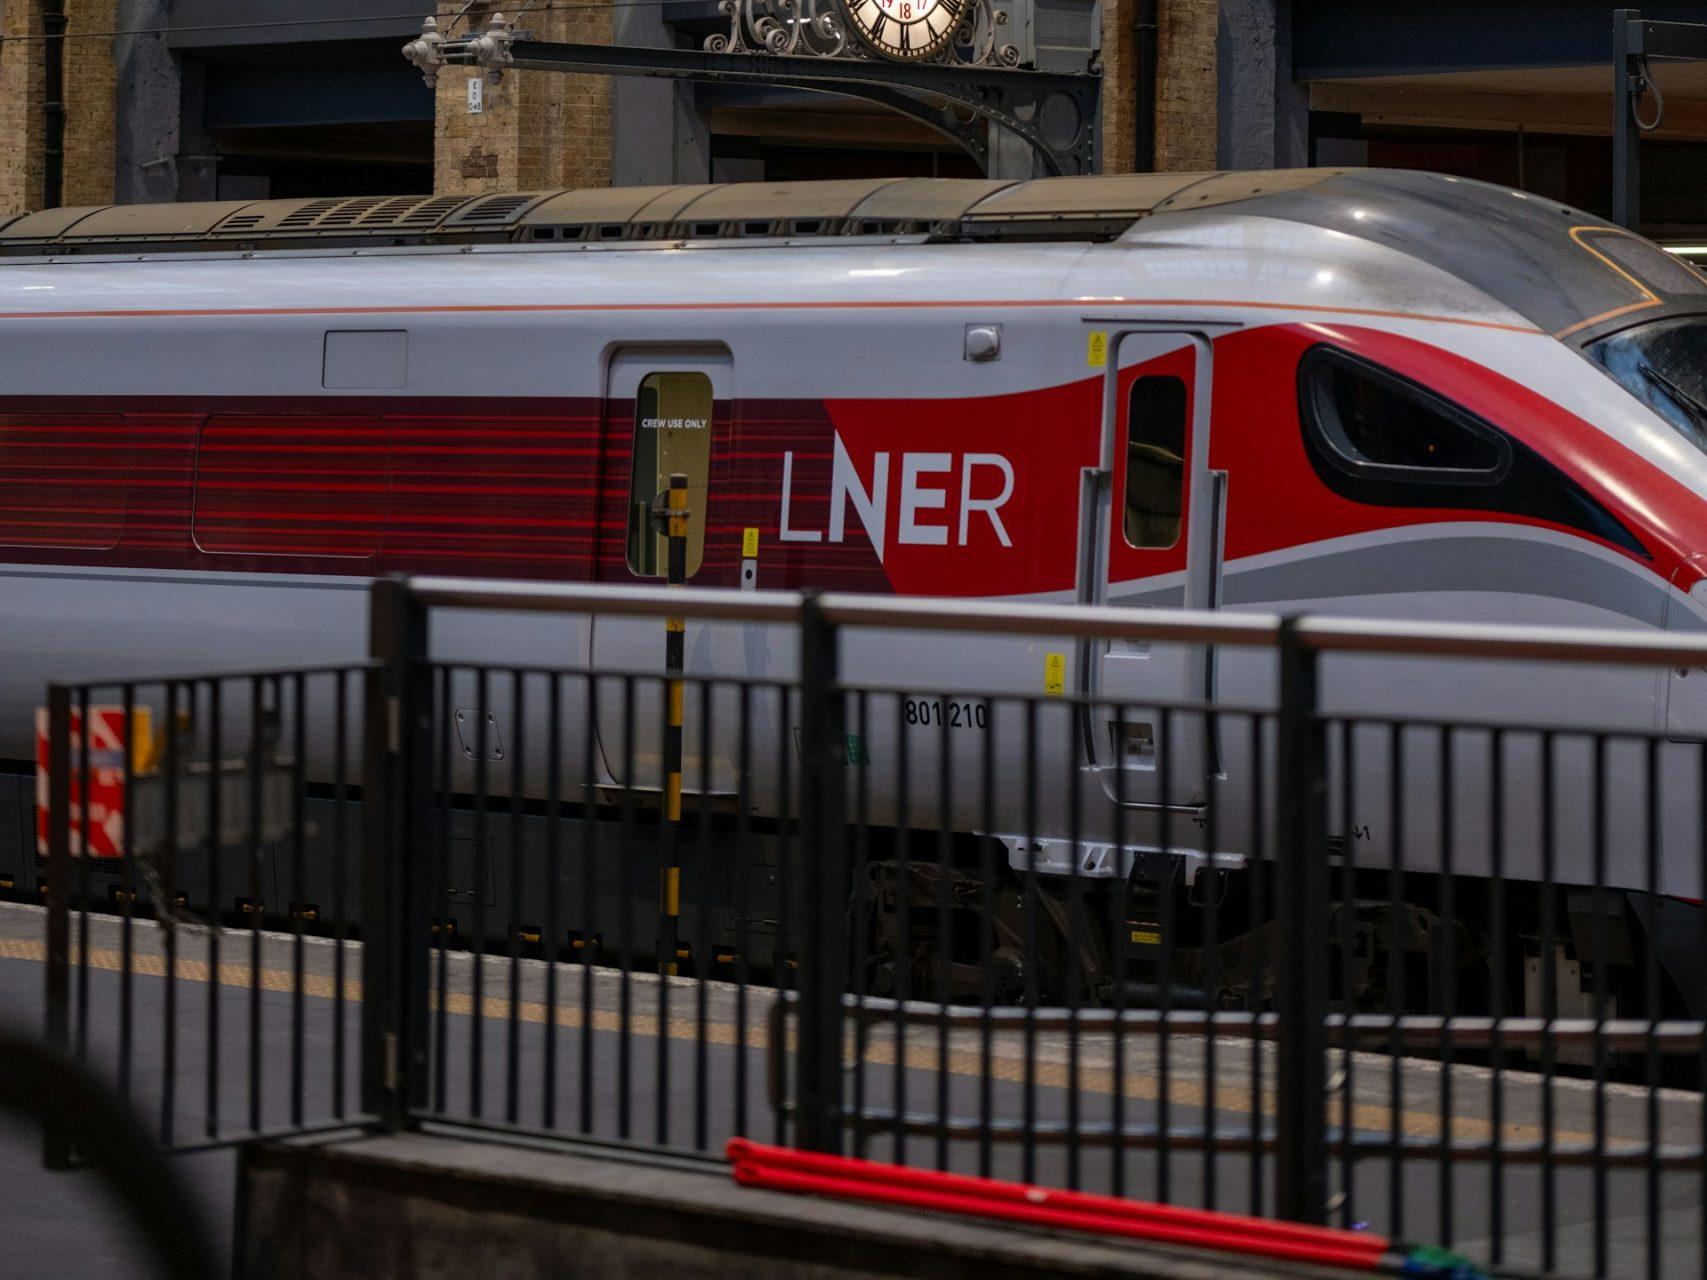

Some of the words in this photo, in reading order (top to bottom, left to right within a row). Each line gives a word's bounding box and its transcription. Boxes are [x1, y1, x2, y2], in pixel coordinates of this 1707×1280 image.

[900, 3, 911, 19] 18
[642, 418, 666, 428] CREW
[667, 418, 683, 428] USE
[684, 418, 707, 428] ONLY
[780, 428, 1015, 566] LNER
[905, 700, 942, 727] 801
[948, 703, 987, 729] 210
